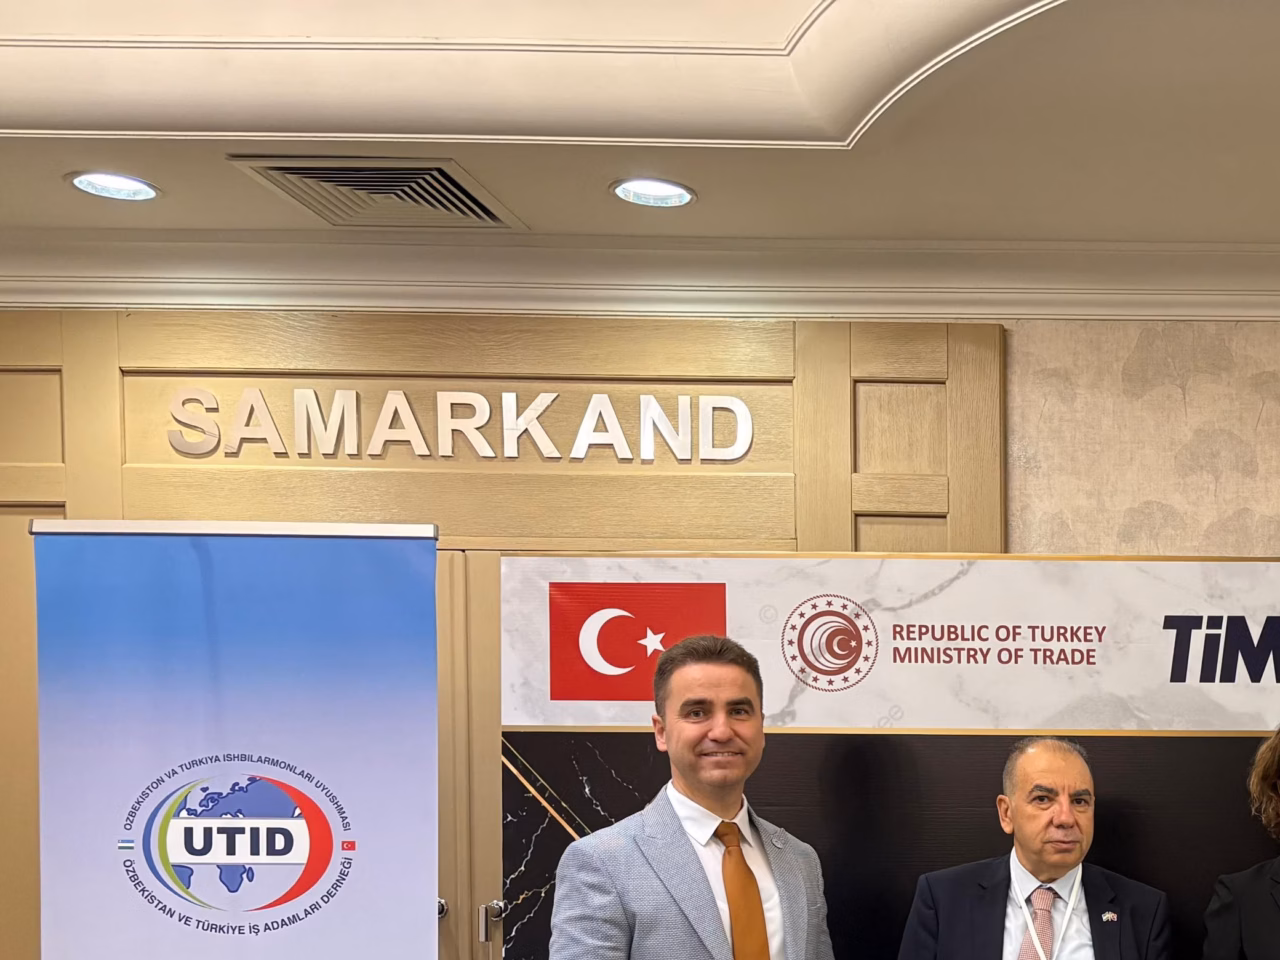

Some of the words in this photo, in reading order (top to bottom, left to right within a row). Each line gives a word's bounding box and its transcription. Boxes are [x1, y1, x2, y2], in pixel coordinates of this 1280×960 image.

[167, 387, 754, 461] SAMARKAND
[893, 624, 989, 641] REPUBLIC
[996, 625, 1021, 642] OF
[1028, 626, 1106, 642] TURKEY
[893, 647, 991, 664] MINISTRY
[997, 648, 1023, 664] OF
[1030, 649, 1096, 665] TRADE
[164, 768, 178, 779] VA
[178, 755, 220, 773] TURKIYA
[315, 780, 351, 831] UYUSHMASI
[183, 826, 294, 857] UTID
[123, 859, 176, 918] ÖZBEKİSTAN
[178, 912, 193, 926] VE
[195, 919, 245, 934] TÜRKİYE
[248, 922, 260, 936] İŞ
[263, 901, 322, 932] ADAMLARI
[320, 857, 353, 904] DERNEĞİ
